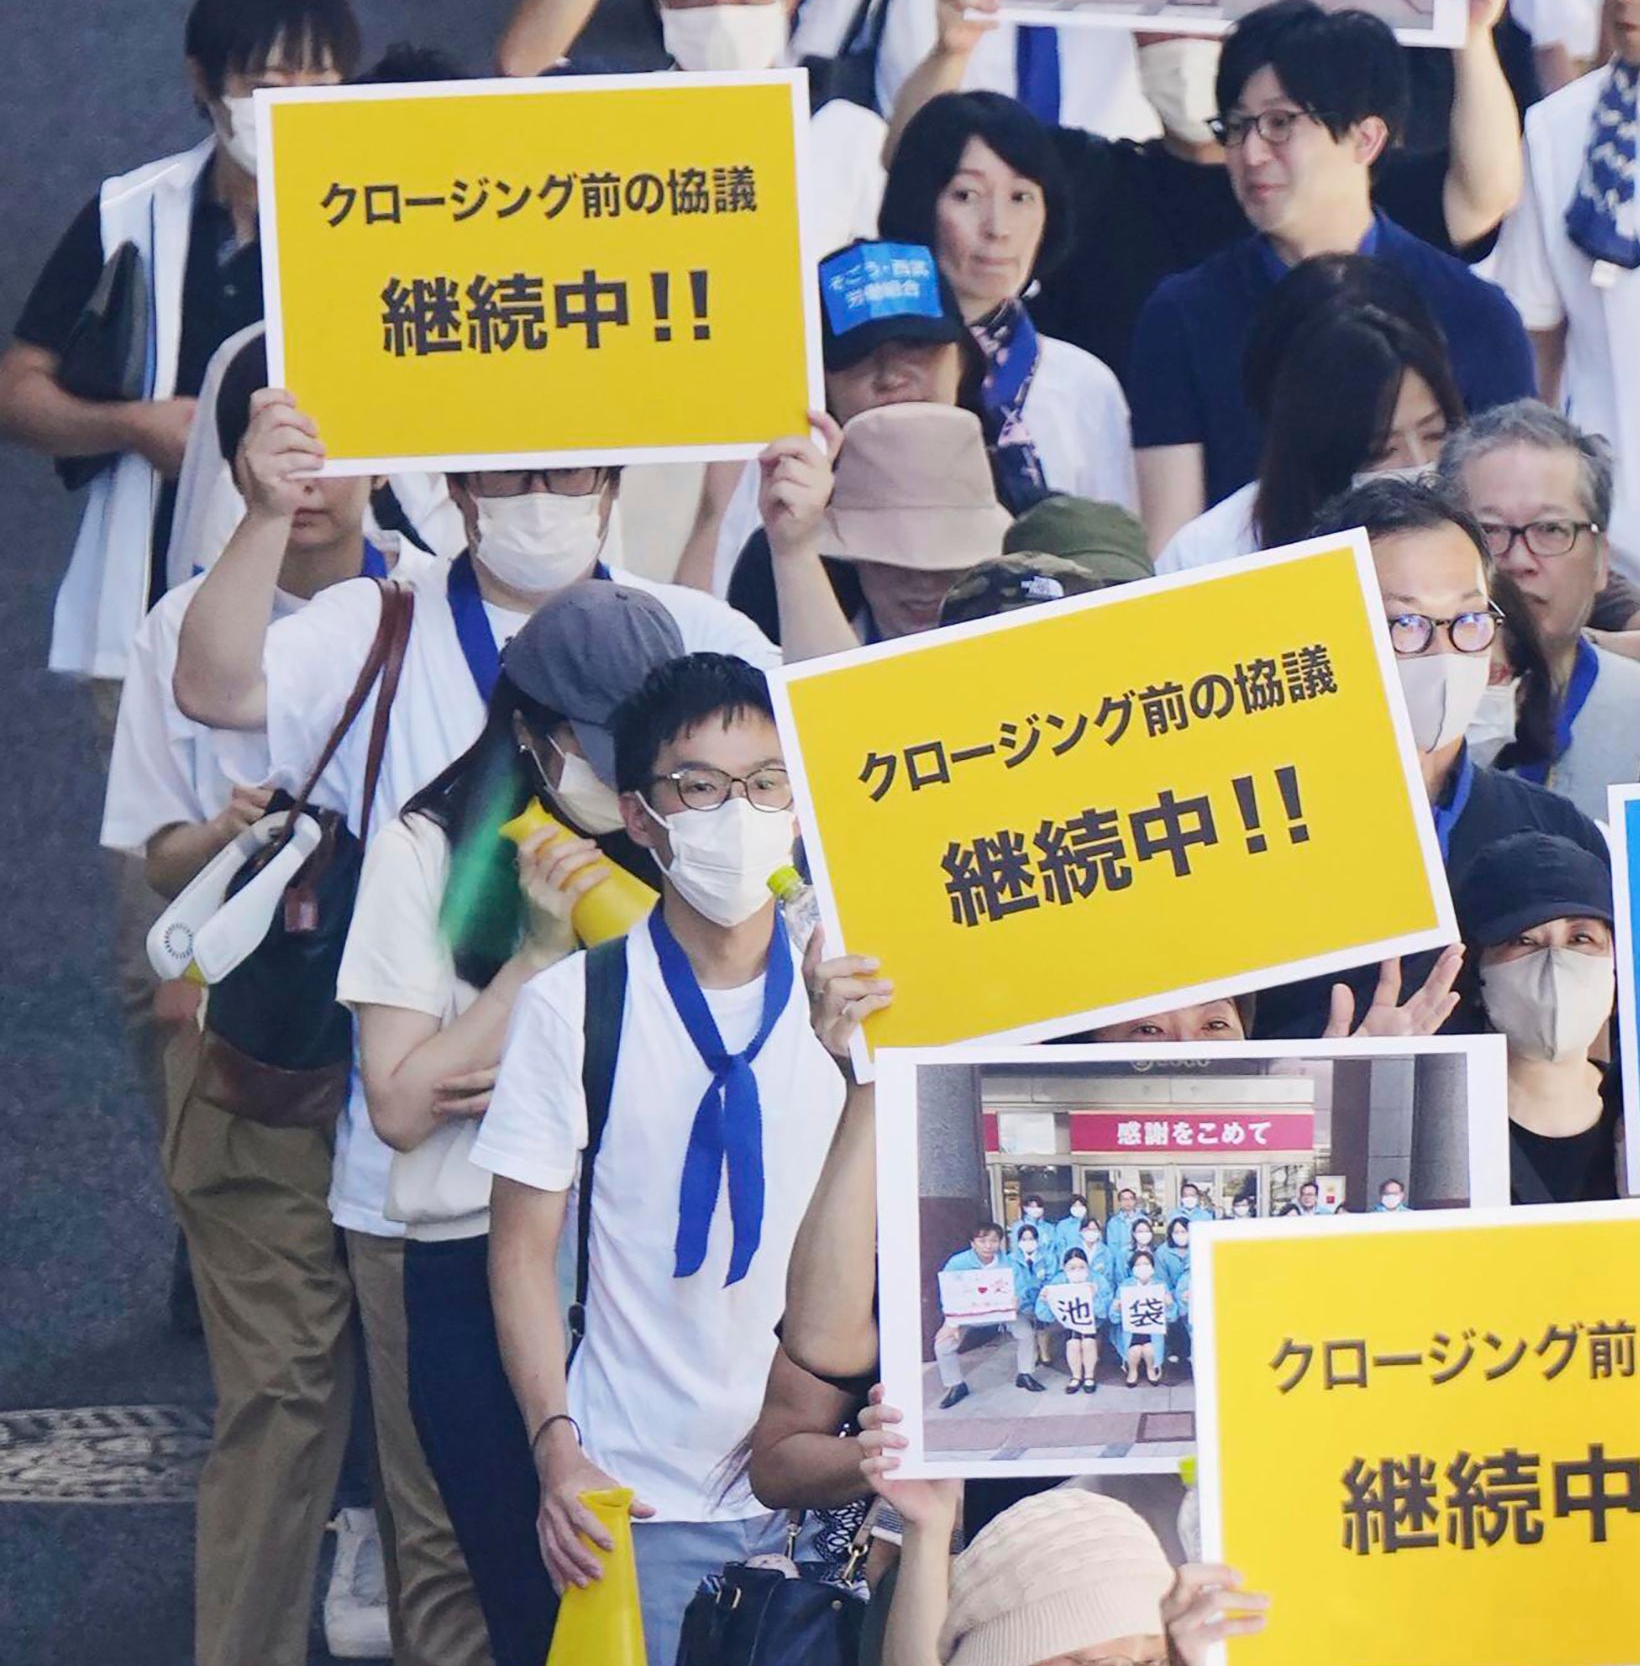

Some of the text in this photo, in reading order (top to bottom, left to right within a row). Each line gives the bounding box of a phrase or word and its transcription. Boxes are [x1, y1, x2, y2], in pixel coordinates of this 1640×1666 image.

[320, 167, 757, 228] クロージング前の協議
[381, 269, 711, 357] 継続中!!
[857, 643, 1338, 803] クロージング前の協議
[939, 765, 1311, 929] 継続中!!
[1116, 1119, 1272, 1147] 感謝をこめて
